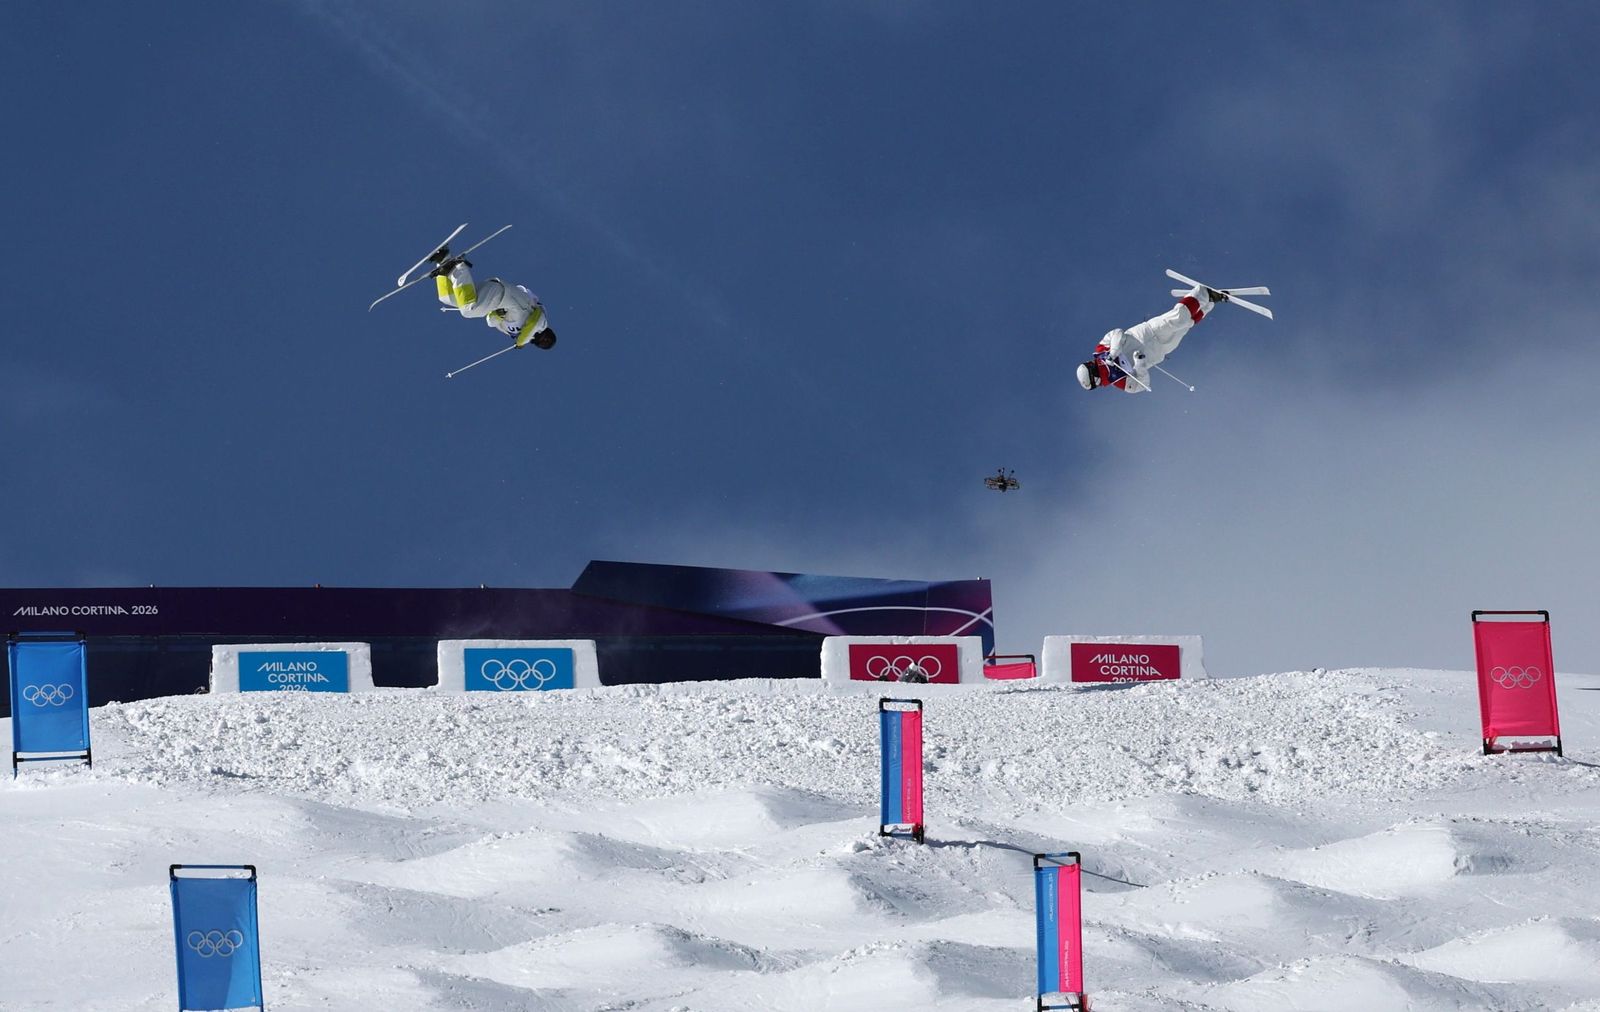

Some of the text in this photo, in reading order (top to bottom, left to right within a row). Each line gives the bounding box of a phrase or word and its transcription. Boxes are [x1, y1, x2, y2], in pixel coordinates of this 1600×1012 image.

[13, 605, 158, 616] MILANO CORTINA 2026
[1089, 654, 1150, 664] MILANO
[257, 662, 317, 672] MILANO
[1100, 665, 1161, 676] CORTINA
[268, 673, 329, 683] CORTINA
[280, 684, 308, 692] 2026
